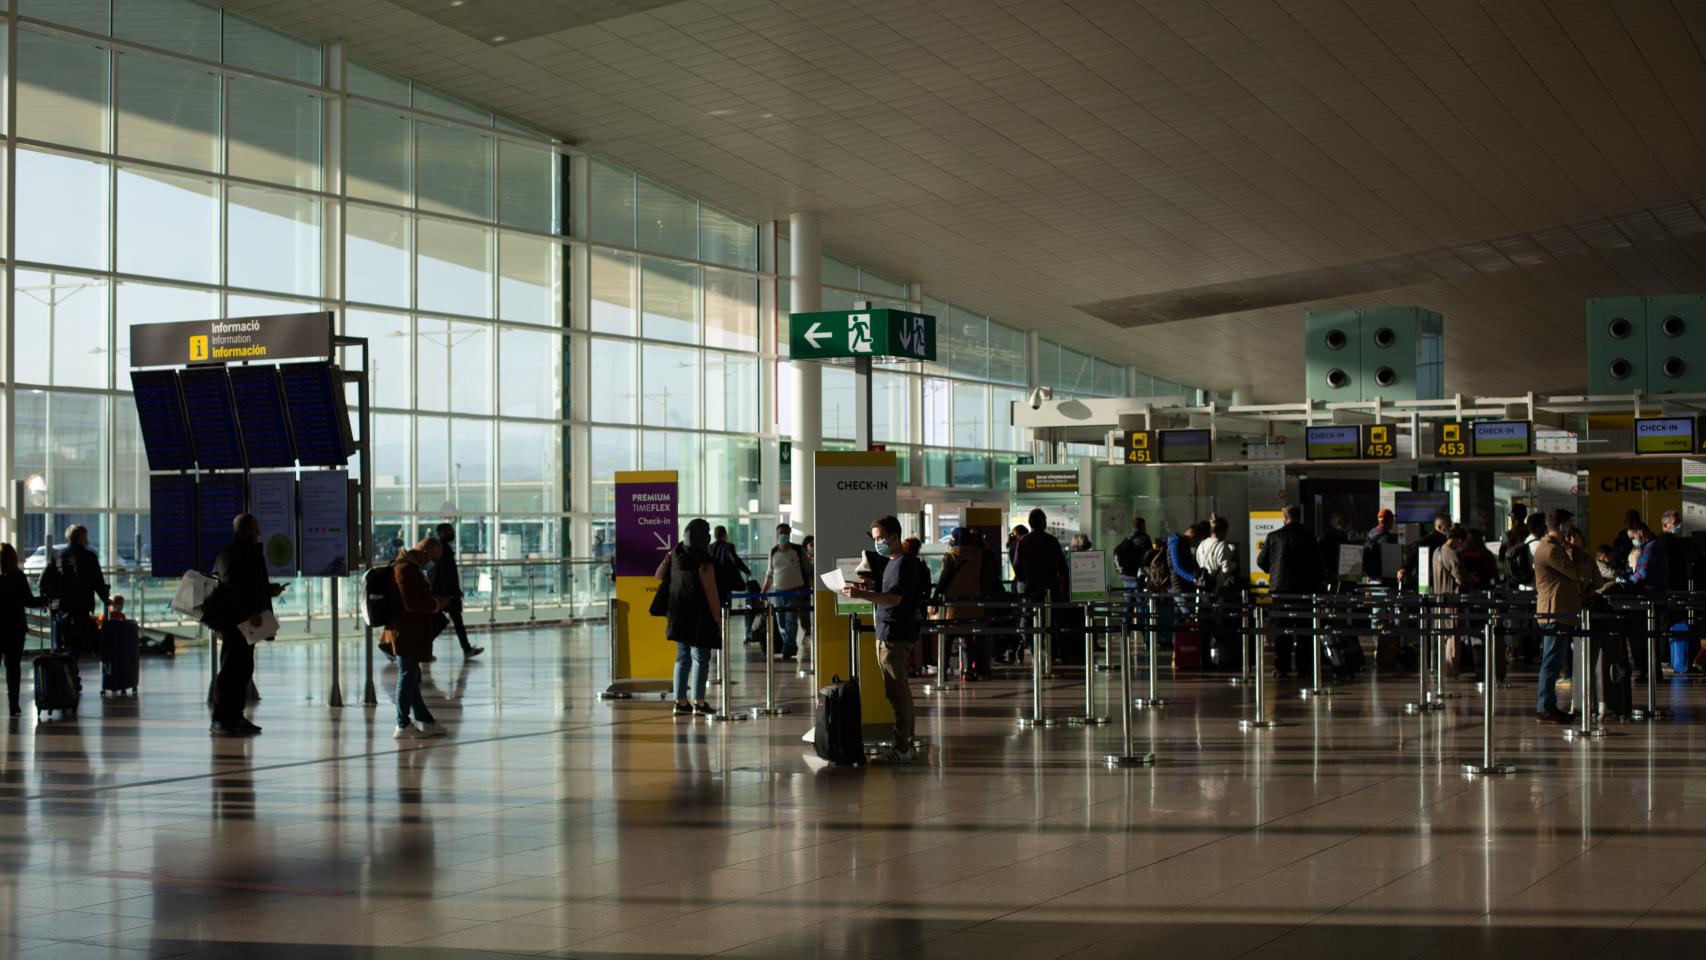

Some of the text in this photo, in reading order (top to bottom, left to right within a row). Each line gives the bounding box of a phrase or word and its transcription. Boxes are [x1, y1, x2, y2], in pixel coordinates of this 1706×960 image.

[212, 320, 260, 334] Informació
[212, 335, 251, 344] Information
[212, 344, 266, 358] Información
[1641, 424, 1678, 432] CHECK-IN
[1367, 445, 1392, 456] 452
[1439, 443, 1465, 455] 453
[1129, 450, 1151, 462] 451
[836, 480, 888, 491] CHECK-IN
[1601, 475, 1682, 492] CHECK-I
[632, 493, 670, 501] PREMIUM
[632, 503, 670, 512] TIMEFLEX
[638, 516, 671, 525] Check-in
